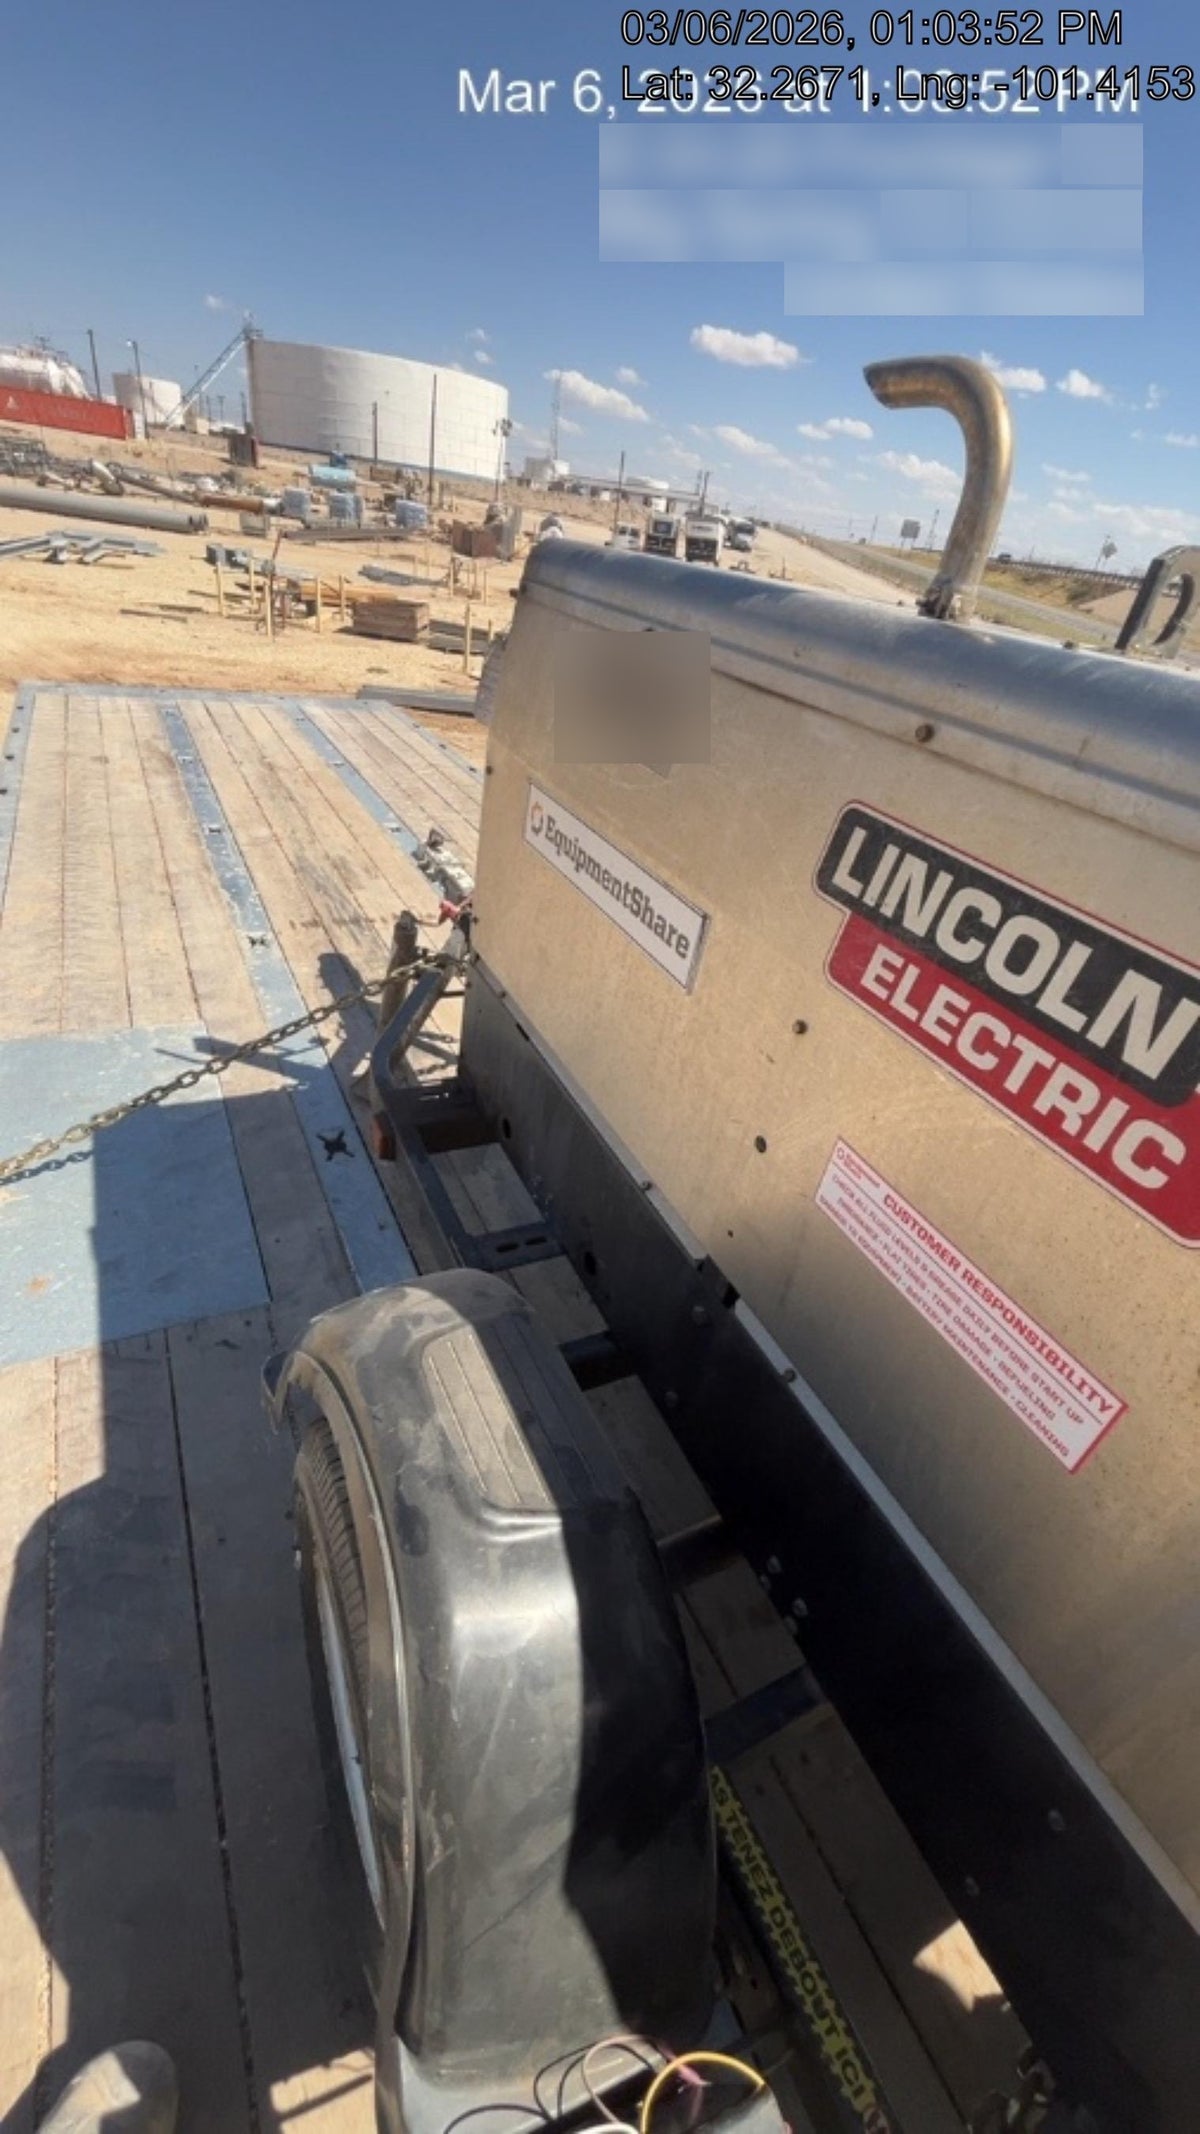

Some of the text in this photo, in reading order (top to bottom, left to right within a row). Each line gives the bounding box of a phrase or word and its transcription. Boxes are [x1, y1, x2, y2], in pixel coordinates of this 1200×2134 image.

[545, 815, 691, 959] EquipmentShare
[831, 827, 1200, 1081] LINCOLN
[860, 943, 1187, 1190] ELECTRIC
[883, 1193, 1112, 1415] CUSTOMER RESPONSIBILITY
[1030, 1371, 1065, 1407] START
[1015, 1400, 1069, 1457] CLEANING
[725, 1810, 774, 1900] TENEZ
[769, 1905, 840, 2038] DEBOUT
[835, 2048, 866, 2098] ICI
